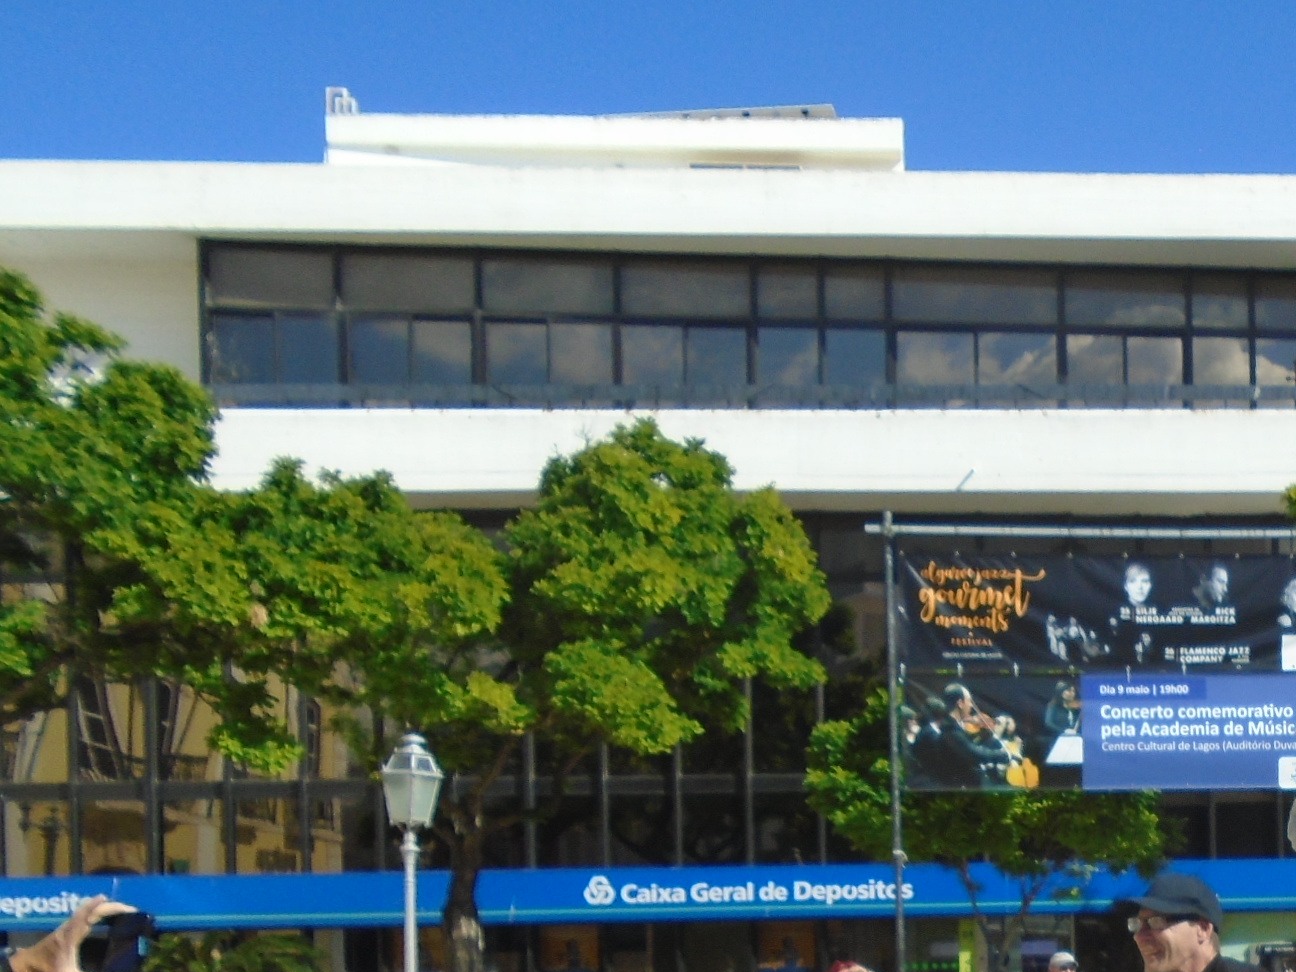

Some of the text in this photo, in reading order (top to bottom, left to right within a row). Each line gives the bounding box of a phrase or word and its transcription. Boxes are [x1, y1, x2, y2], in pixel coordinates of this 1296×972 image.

[1180, 647, 1226, 656] FLAMENCO
[1228, 646, 1250, 655] JAZZ
[1180, 655, 1223, 664] COMPANY
[1100, 684, 1189, 695] Dia 9 maio 19h00
[1100, 704, 1174, 719] Concerto
[1178, 703, 1293, 719] comemorativo
[1101, 721, 1136, 740] pela
[1140, 721, 1220, 736] Academia
[1224, 721, 1244, 736] de
[1102, 741, 1135, 752] Centro
[1138, 741, 1175, 751] Cultural
[1178, 741, 1190, 751] de
[1193, 741, 1220, 753] Lagos
[620, 883, 686, 904] Caixa
[690, 882, 755, 902] Geral
[759, 881, 788, 901] de
[0, 891, 88, 918] eposit
